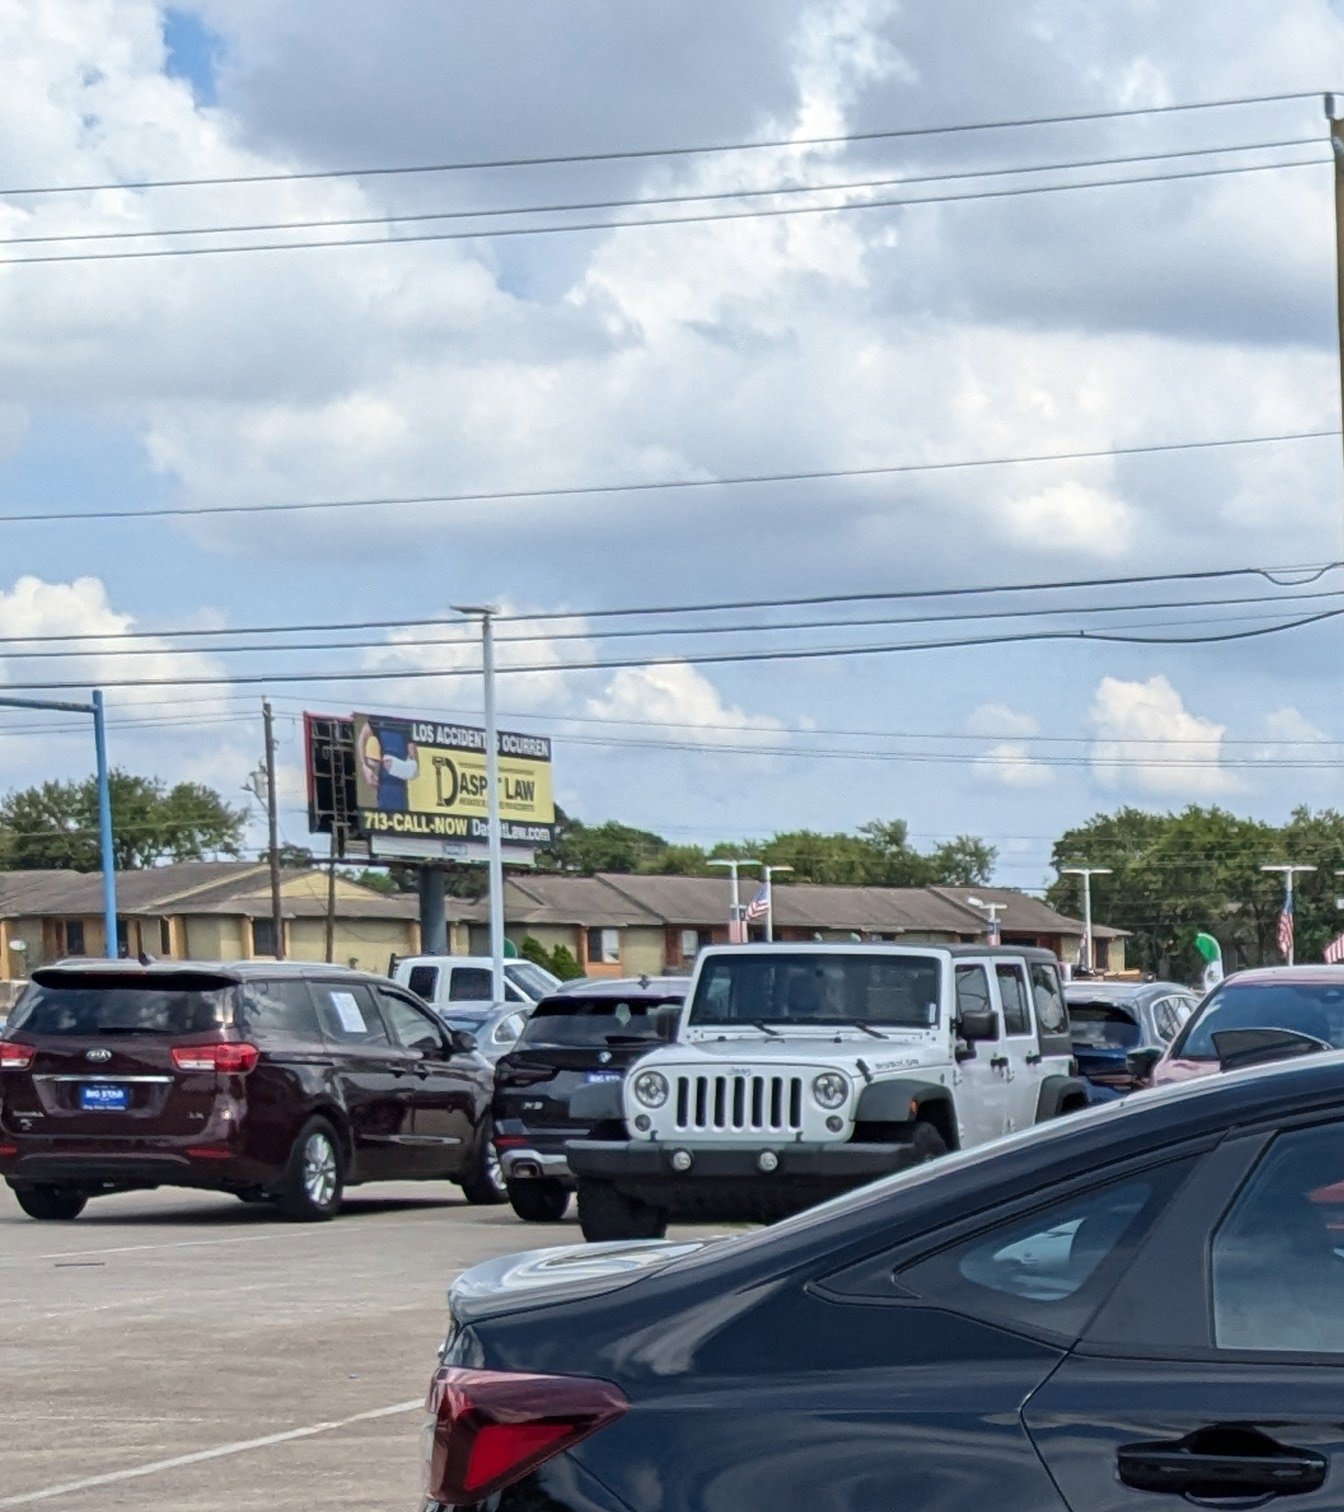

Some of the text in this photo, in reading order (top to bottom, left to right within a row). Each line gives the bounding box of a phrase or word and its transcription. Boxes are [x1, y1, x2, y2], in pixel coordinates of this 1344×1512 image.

[412, 723, 550, 757] LOS ACCIDENTS OCURREN
[504, 777, 535, 802] LAW
[364, 811, 468, 836] 713-CALL-NOW
